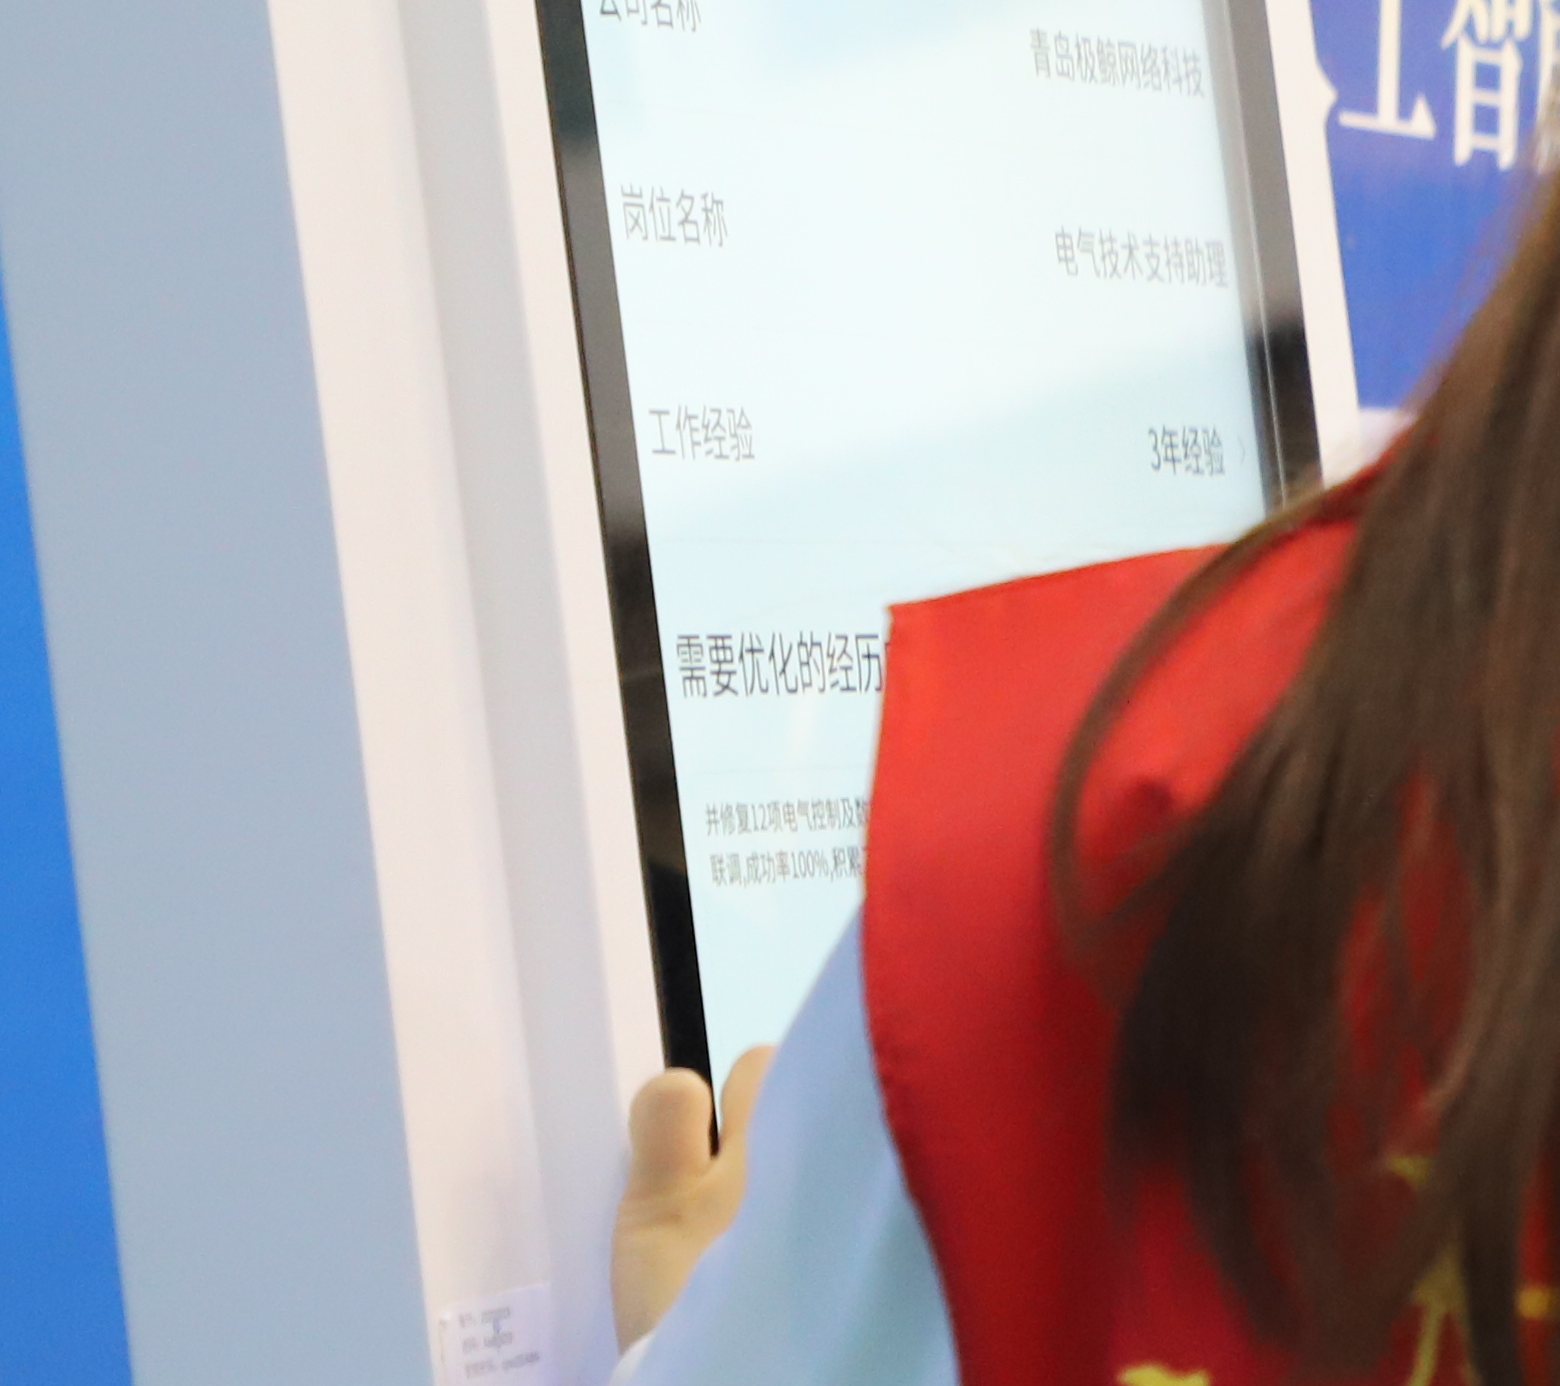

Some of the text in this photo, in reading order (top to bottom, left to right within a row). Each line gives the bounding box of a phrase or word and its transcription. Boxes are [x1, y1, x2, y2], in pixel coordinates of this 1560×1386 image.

[620, 183, 728, 248] 岗位名称
[1054, 225, 1229, 289] 电气技术支持助理
[649, 405, 755, 462] 工作经验
[1148, 424, 1225, 476] 3年经验
[676, 631, 889, 698] 需要优化的经历
